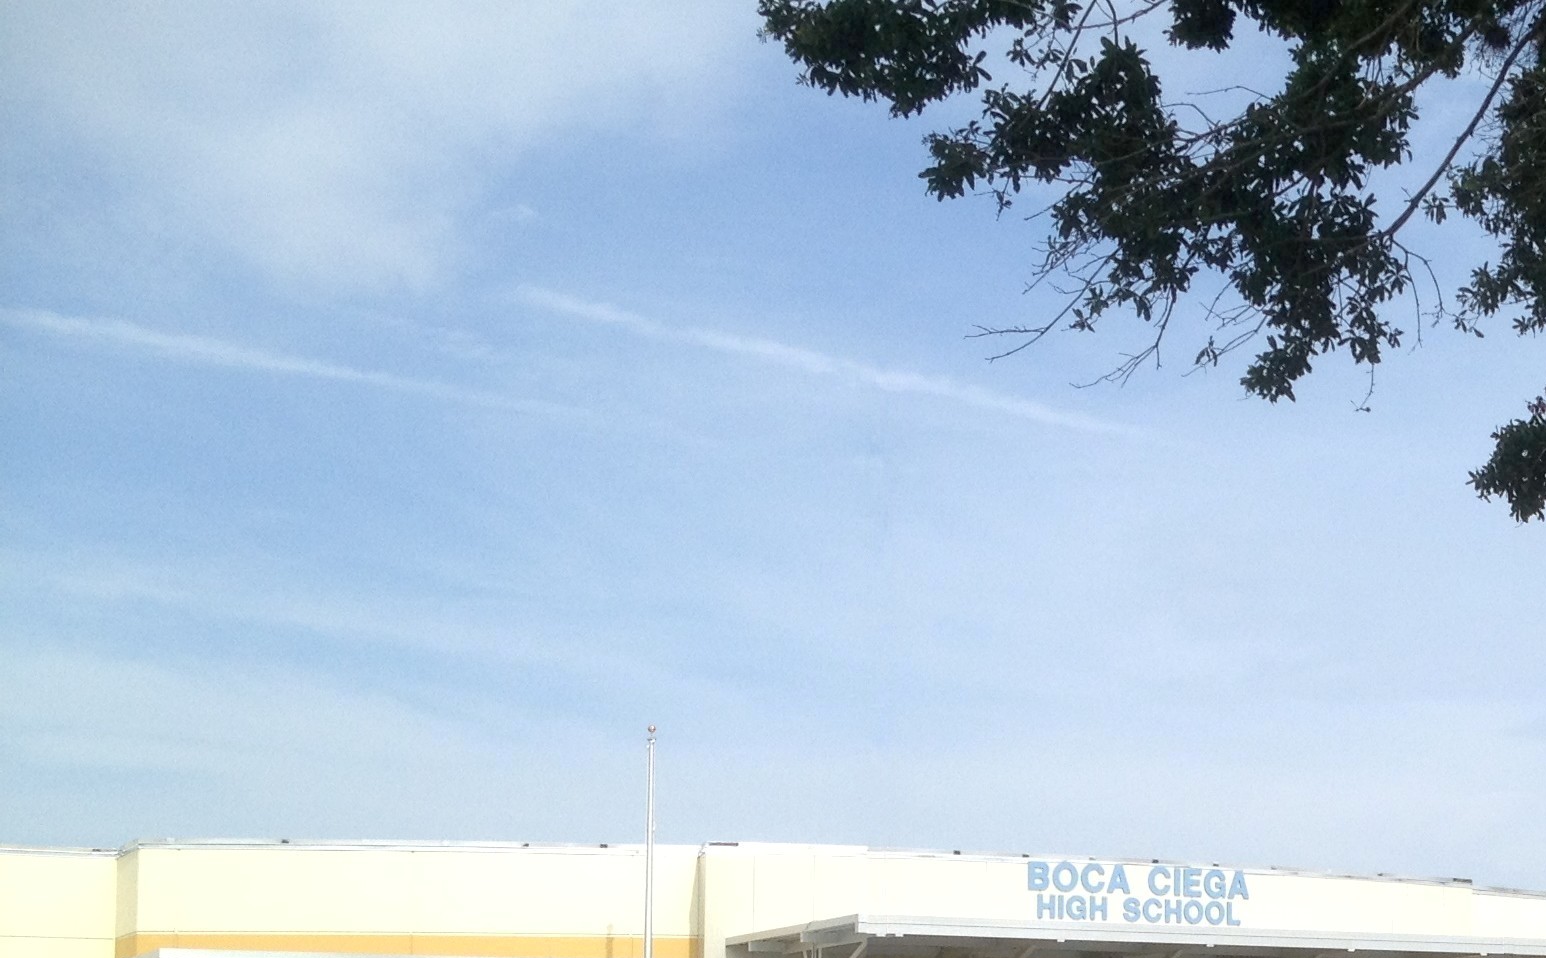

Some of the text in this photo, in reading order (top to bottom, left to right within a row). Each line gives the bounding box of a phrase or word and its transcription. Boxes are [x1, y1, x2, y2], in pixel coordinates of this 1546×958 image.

[1027, 860, 1249, 900] BOCA CIEGA
[1036, 893, 1241, 927] HIGH SCHOOL
